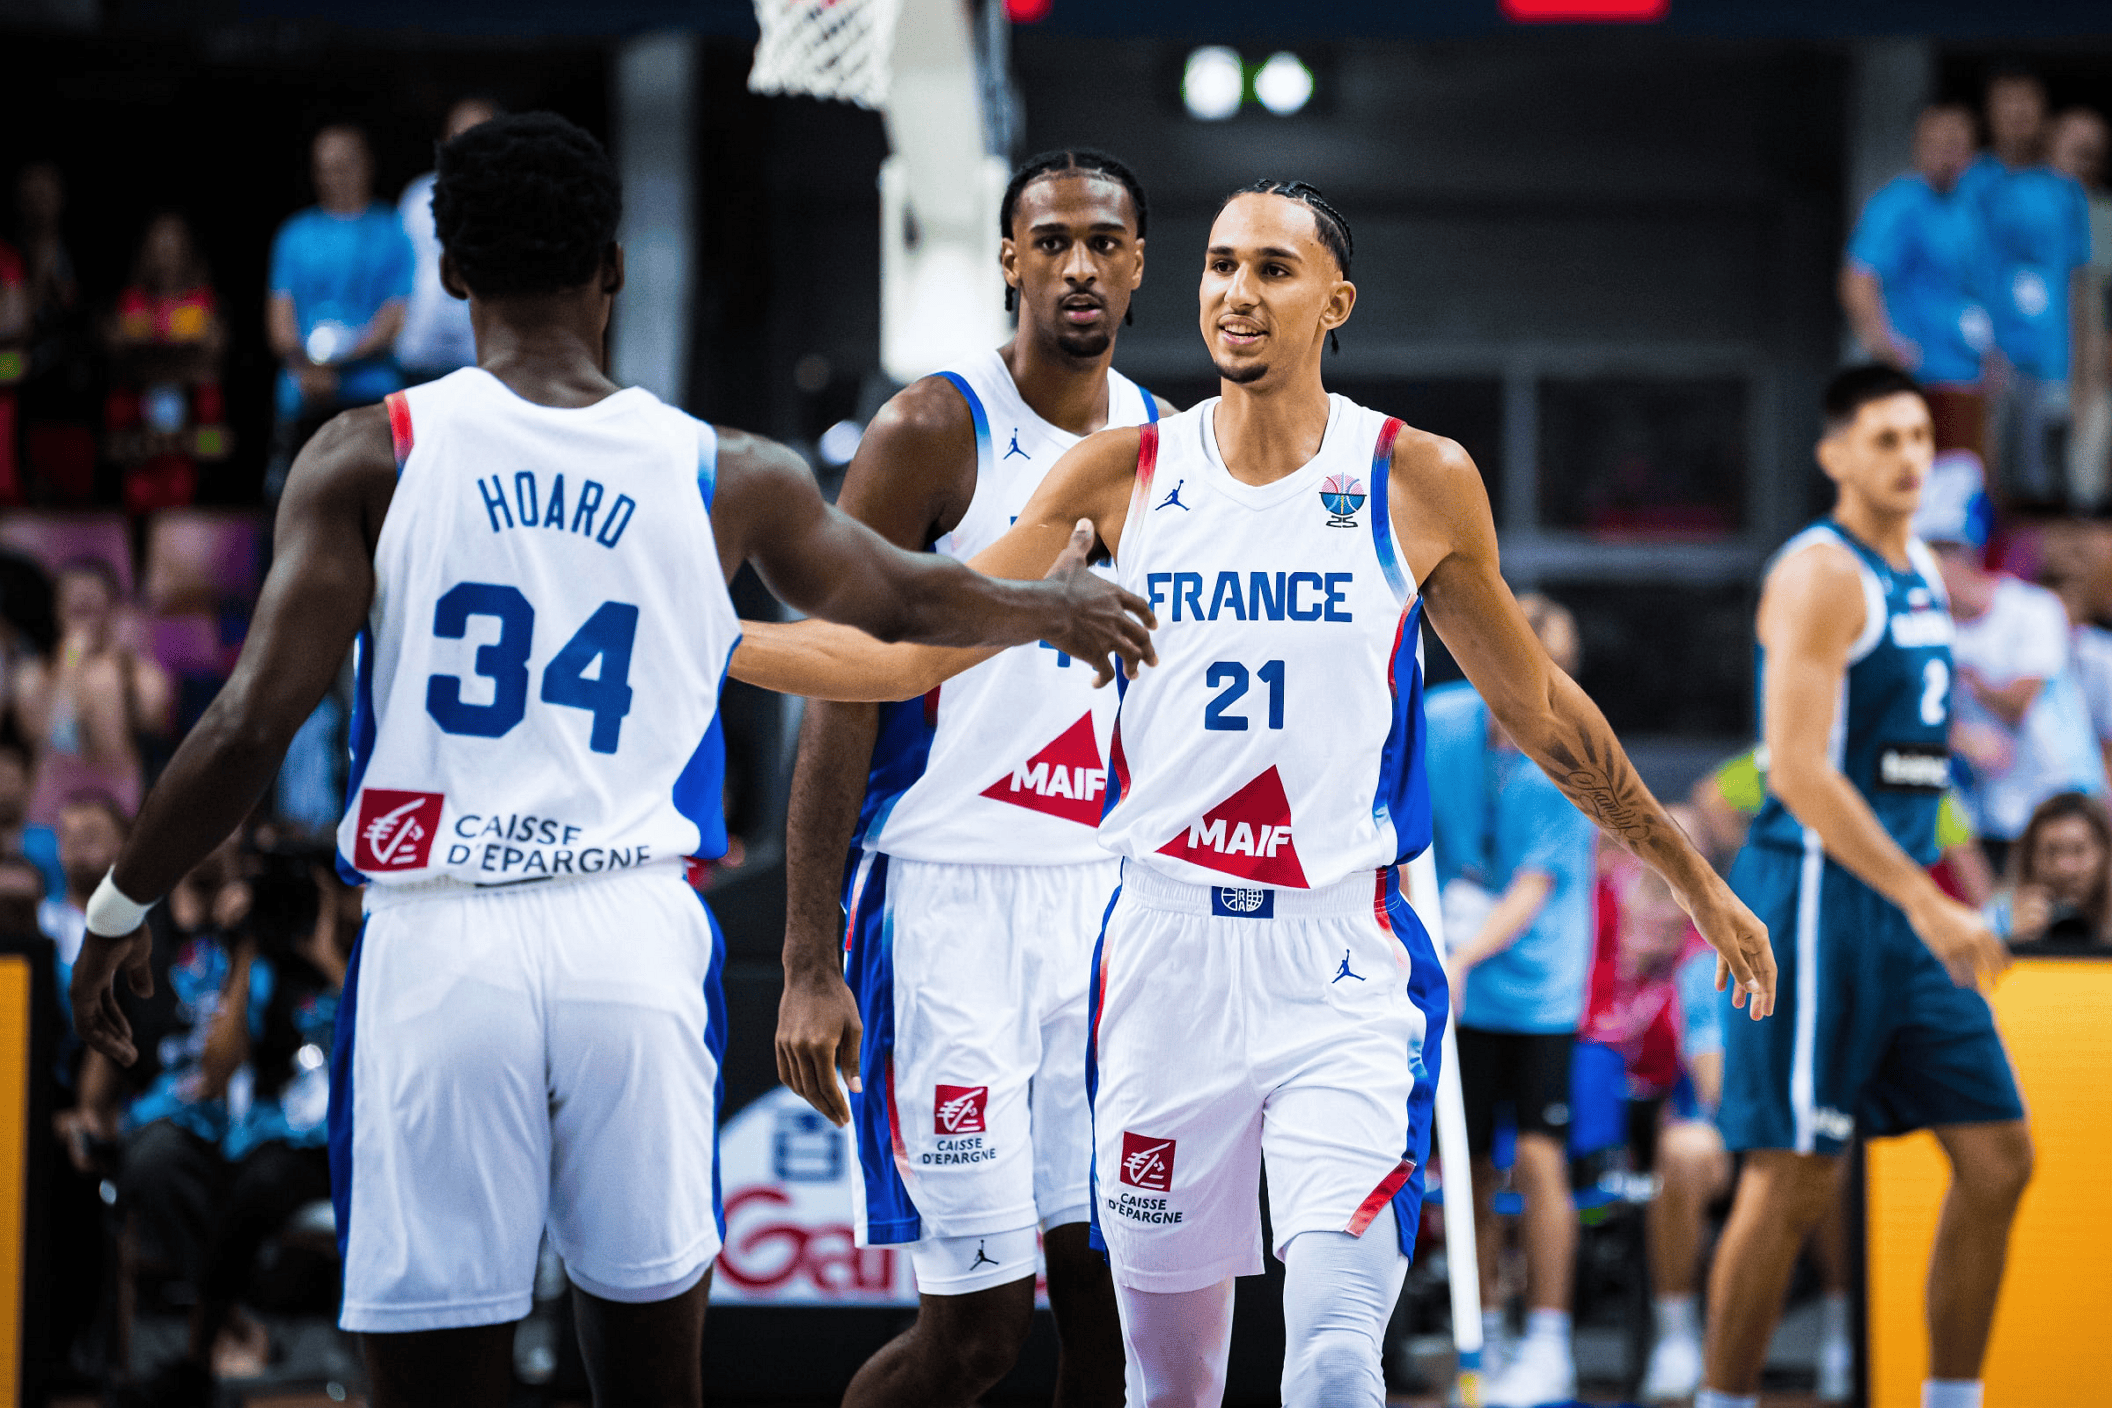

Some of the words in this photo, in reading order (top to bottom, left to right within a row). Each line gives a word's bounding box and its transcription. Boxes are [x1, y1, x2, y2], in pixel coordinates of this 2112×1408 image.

[477, 470, 637, 549] HOARD
[1147, 571, 1353, 622] FRANCE
[425, 581, 639, 754] 34
[1204, 660, 1285, 731] 21
[1009, 762, 1106, 802] MAIF
[1187, 818, 1293, 858] MAIF
[922, 1148, 996, 1165] D'EPARGNE
[937, 1138, 983, 1152] CAISSE
[1108, 1199, 1183, 1224] D'EPARGNE
[1120, 1193, 1167, 1211] CAISSE
